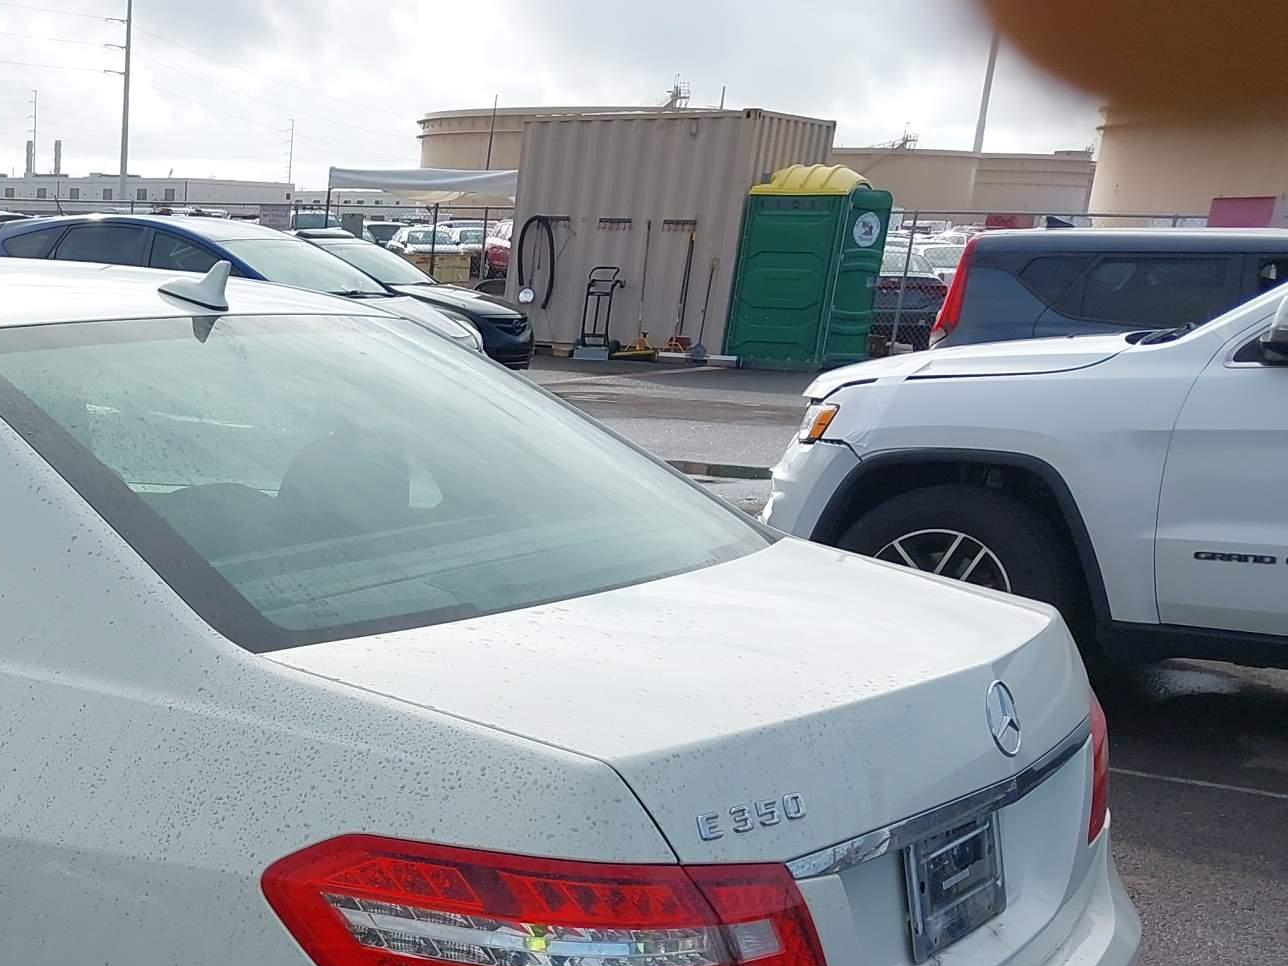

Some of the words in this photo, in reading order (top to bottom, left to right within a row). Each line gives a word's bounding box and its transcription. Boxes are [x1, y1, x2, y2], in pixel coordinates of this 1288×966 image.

[1194, 551, 1277, 565] GRAND
[696, 812, 724, 841] E
[729, 791, 808, 833] 350
